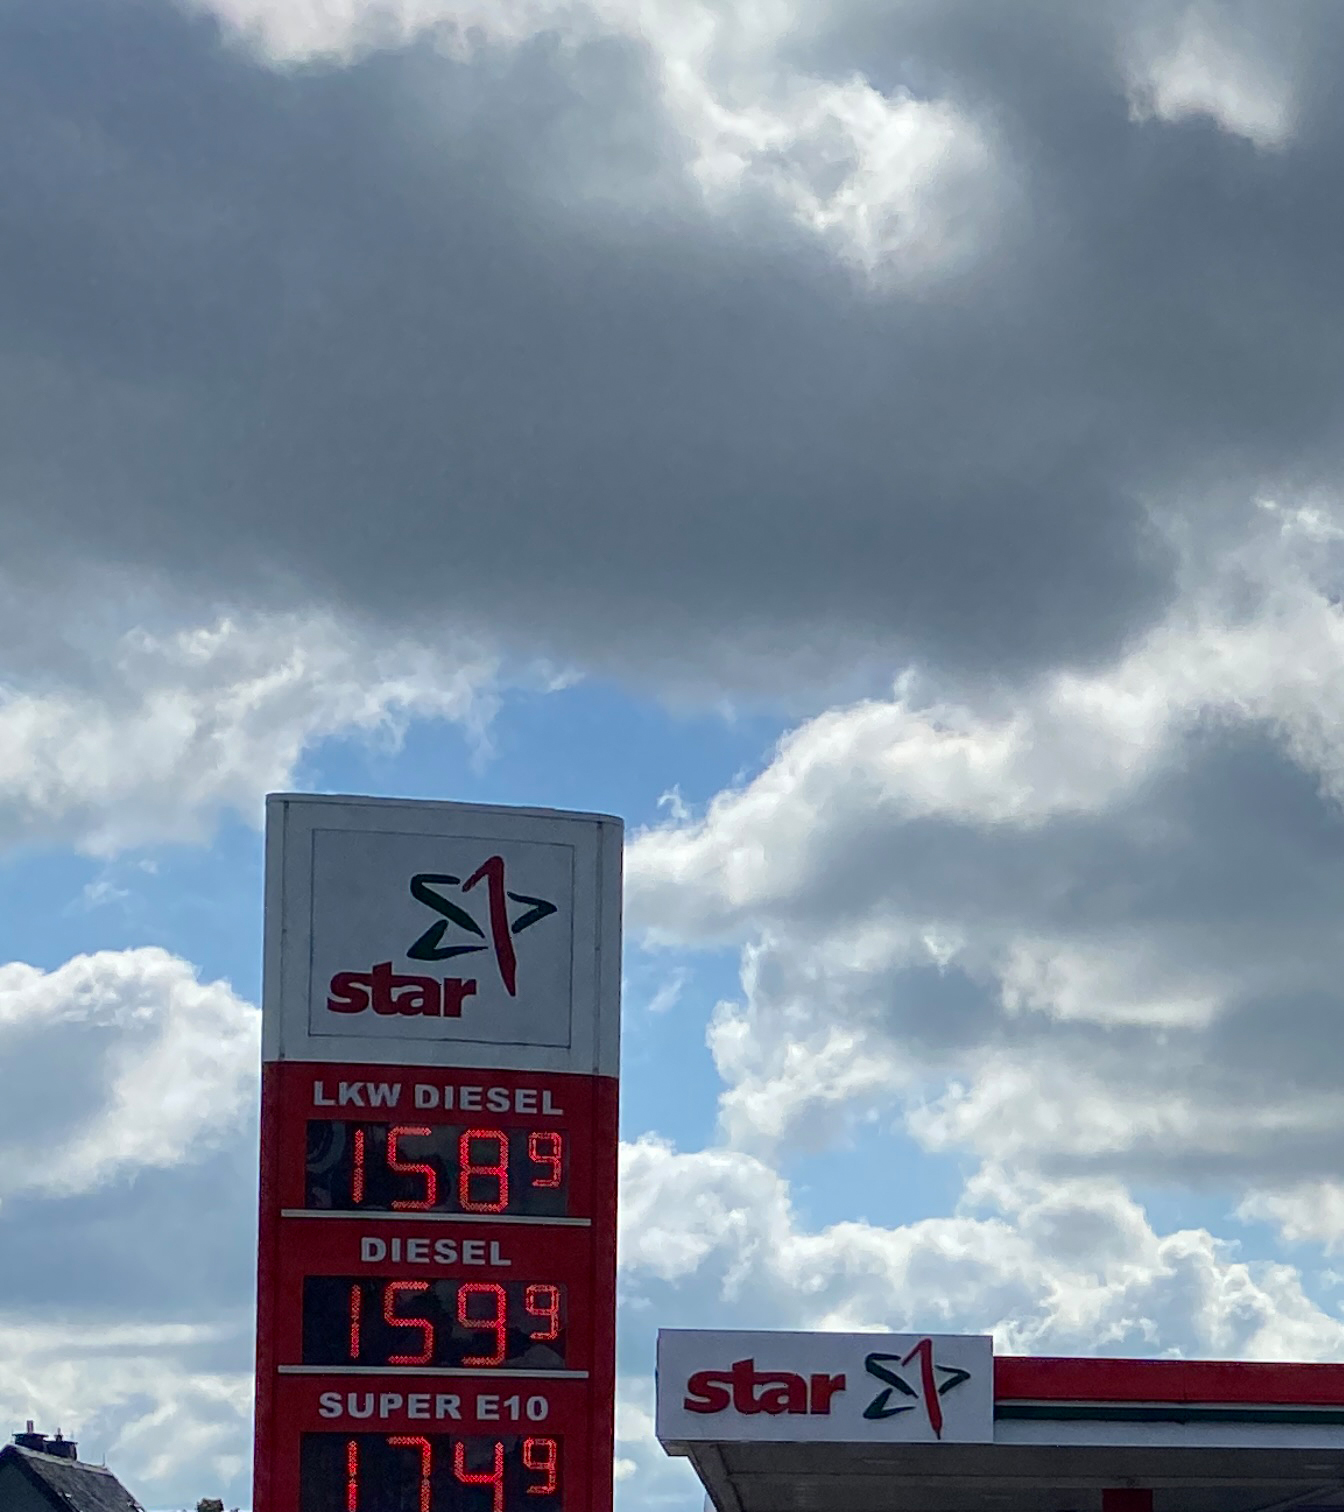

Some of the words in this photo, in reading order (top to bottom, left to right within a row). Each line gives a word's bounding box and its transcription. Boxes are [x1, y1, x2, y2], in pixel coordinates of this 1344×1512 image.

[327, 961, 476, 1018] star
[313, 1080, 402, 1107] LKW
[413, 1084, 564, 1116] DIESEL
[360, 1236, 512, 1266] DIESEL
[684, 1358, 846, 1415] star
[318, 1391, 462, 1420] SUPER
[476, 1395, 549, 1421] E10
